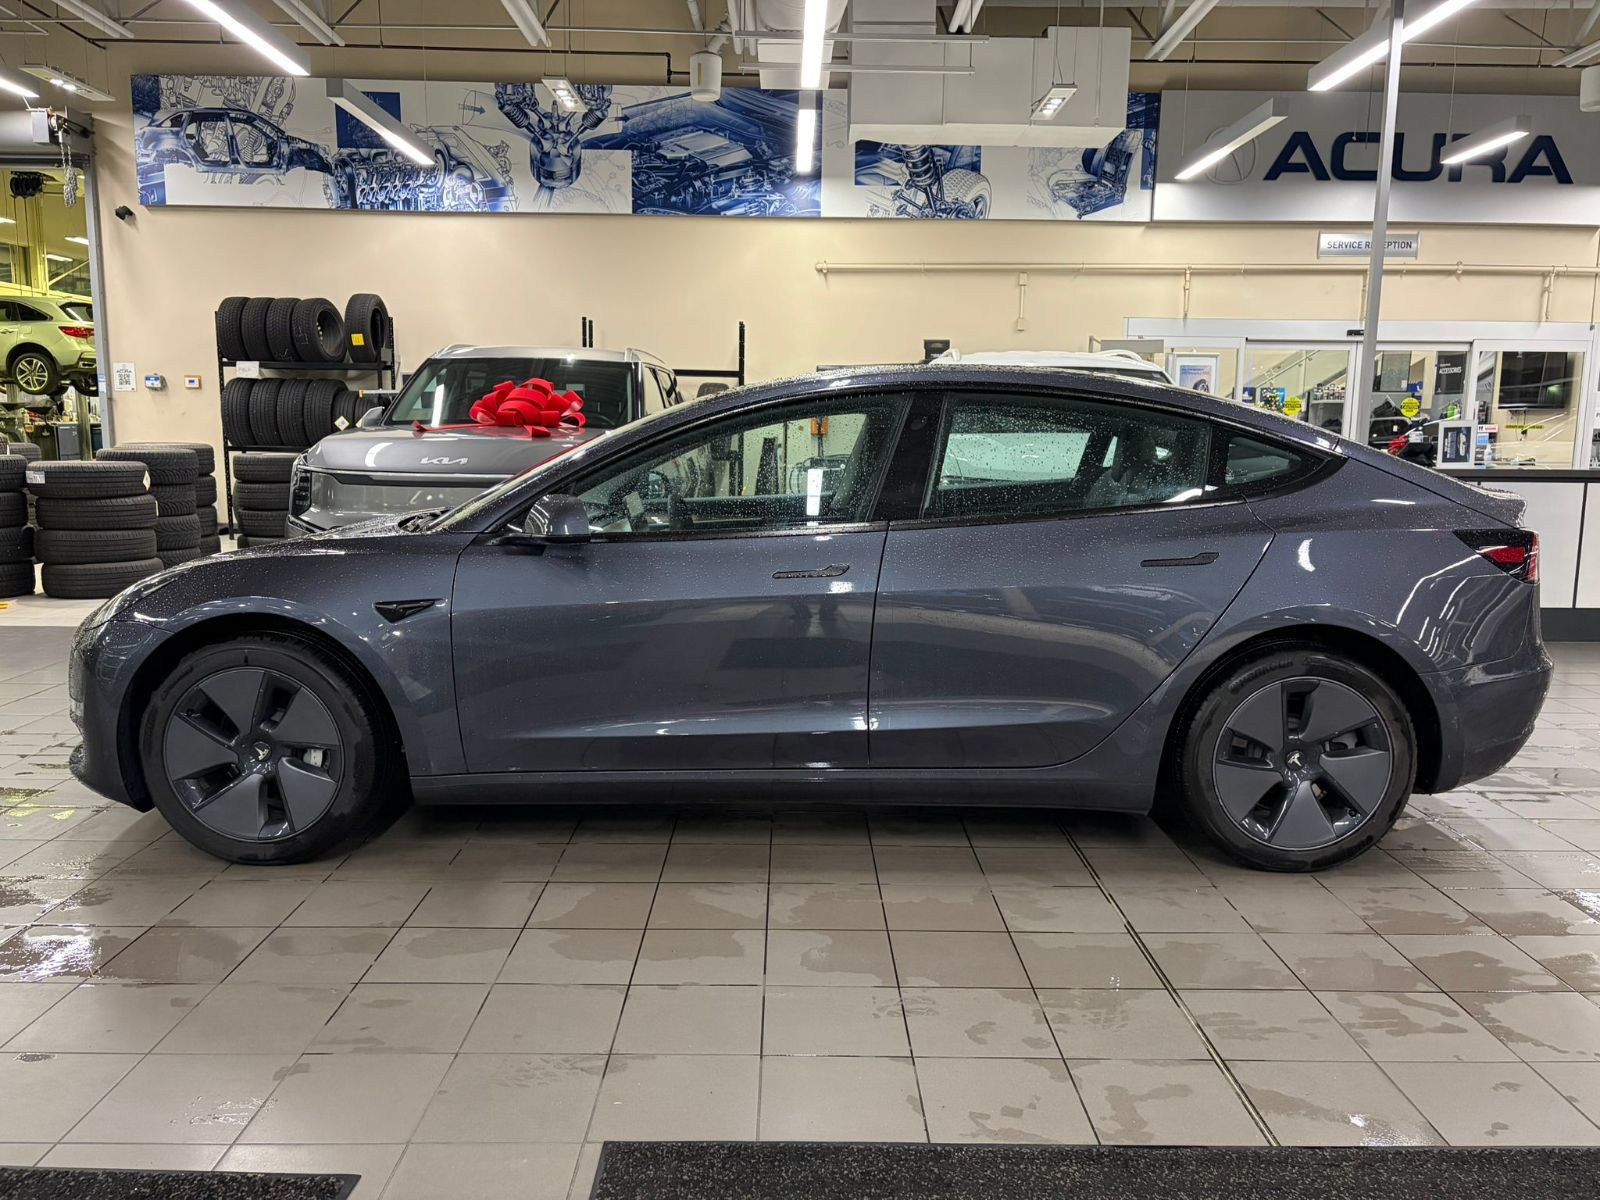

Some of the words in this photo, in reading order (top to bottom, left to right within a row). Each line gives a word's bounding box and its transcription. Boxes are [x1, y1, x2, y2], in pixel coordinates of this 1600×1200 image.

[1263, 130, 1574, 184] ACURA
[1327, 241, 1363, 249] SERVICE
[1365, 241, 1412, 249] REPTION
